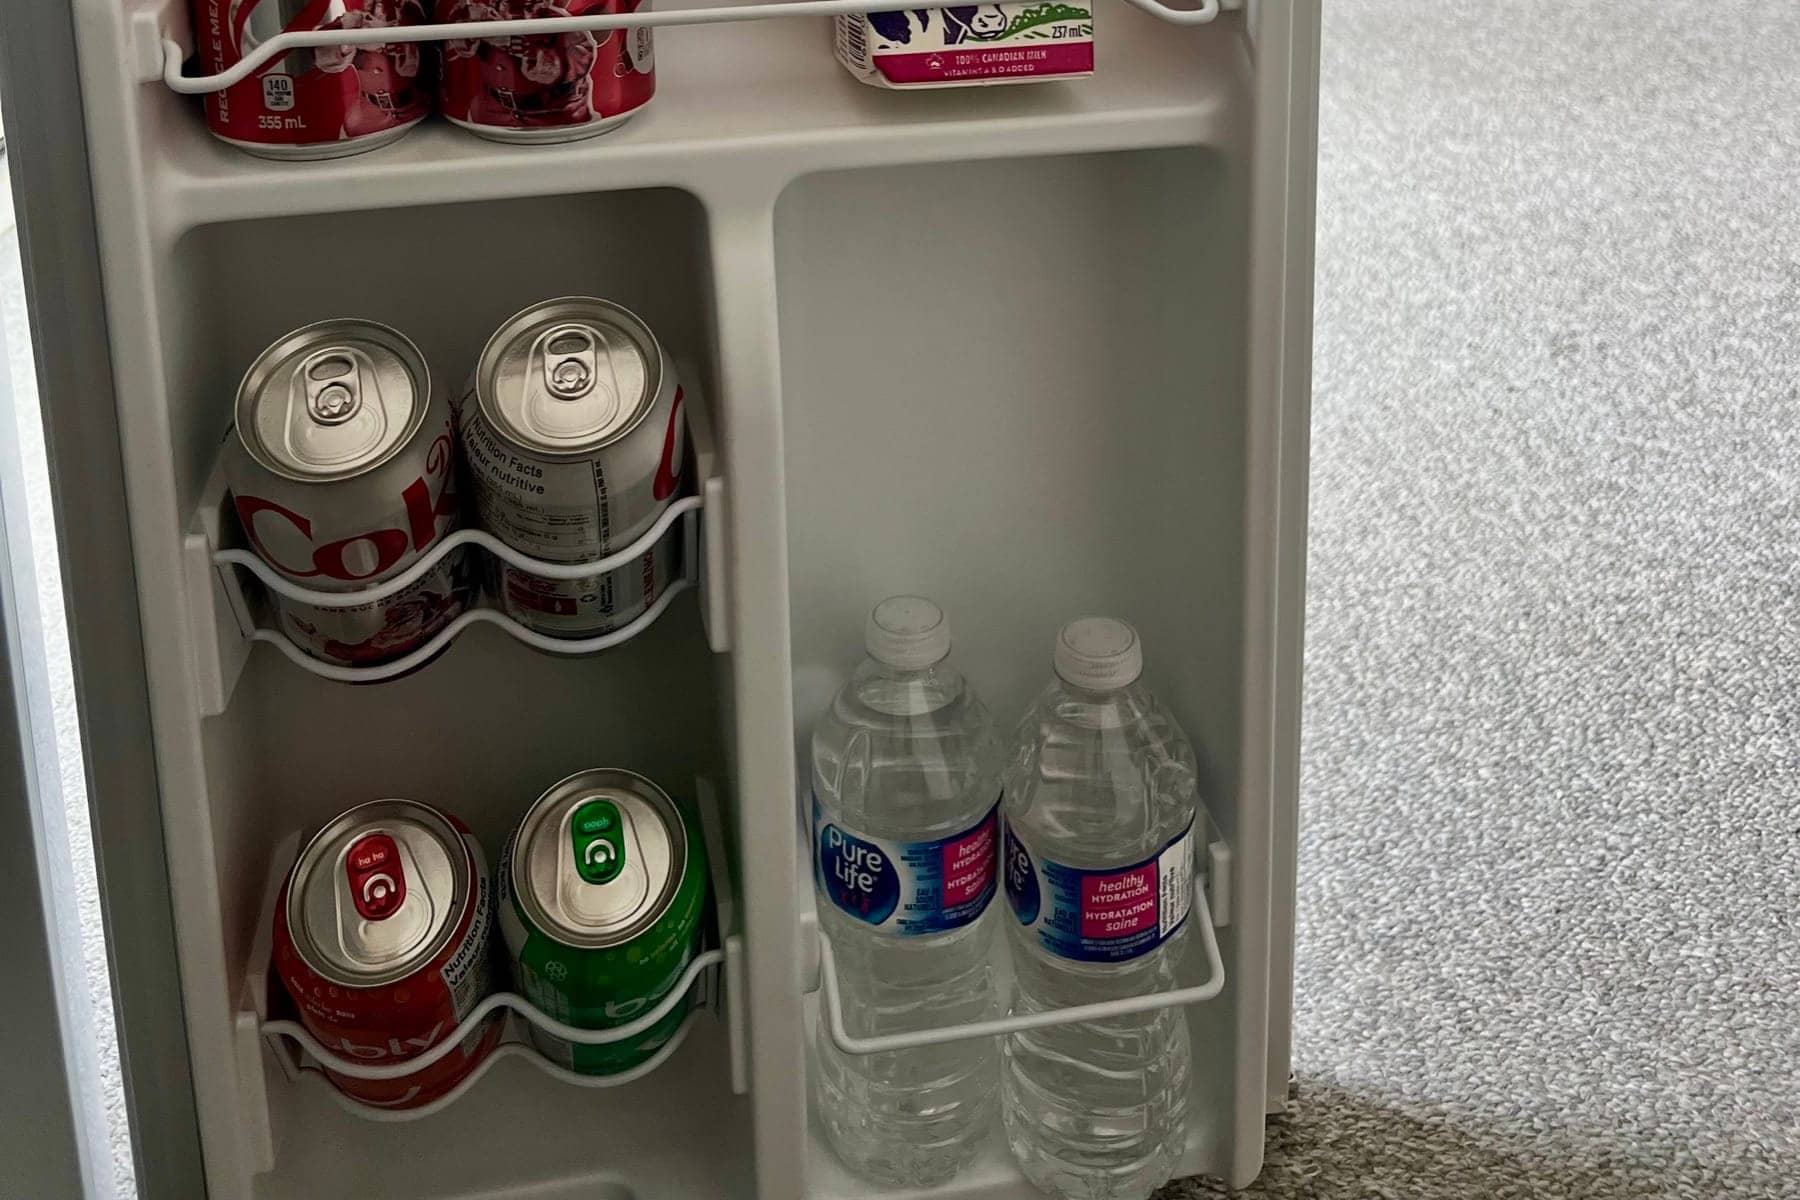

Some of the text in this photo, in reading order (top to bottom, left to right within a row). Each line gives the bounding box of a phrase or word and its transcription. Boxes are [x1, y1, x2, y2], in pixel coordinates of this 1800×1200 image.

[1051, 26, 1069, 39] 237
[982, 50, 1026, 63] CANADIAN
[1026, 49, 1047, 60] MILK
[211, 39, 230, 125] RECCLE
[268, 79, 288, 91] 140
[258, 114, 307, 130] 355 mL
[472, 416, 506, 464] Nutrition
[507, 456, 544, 479] Facts
[465, 428, 492, 471] Valeur
[491, 466, 545, 495] nutritive
[358, 851, 385, 866] ha ha
[829, 826, 882, 873] Pure
[835, 856, 873, 893] Life
[1099, 874, 1144, 893] healthy
[1091, 883, 1149, 904] HYDRATION
[1085, 899, 1154, 921] HYDRATATION
[1105, 916, 1138, 932] saine
[443, 918, 482, 978] Nutrition
